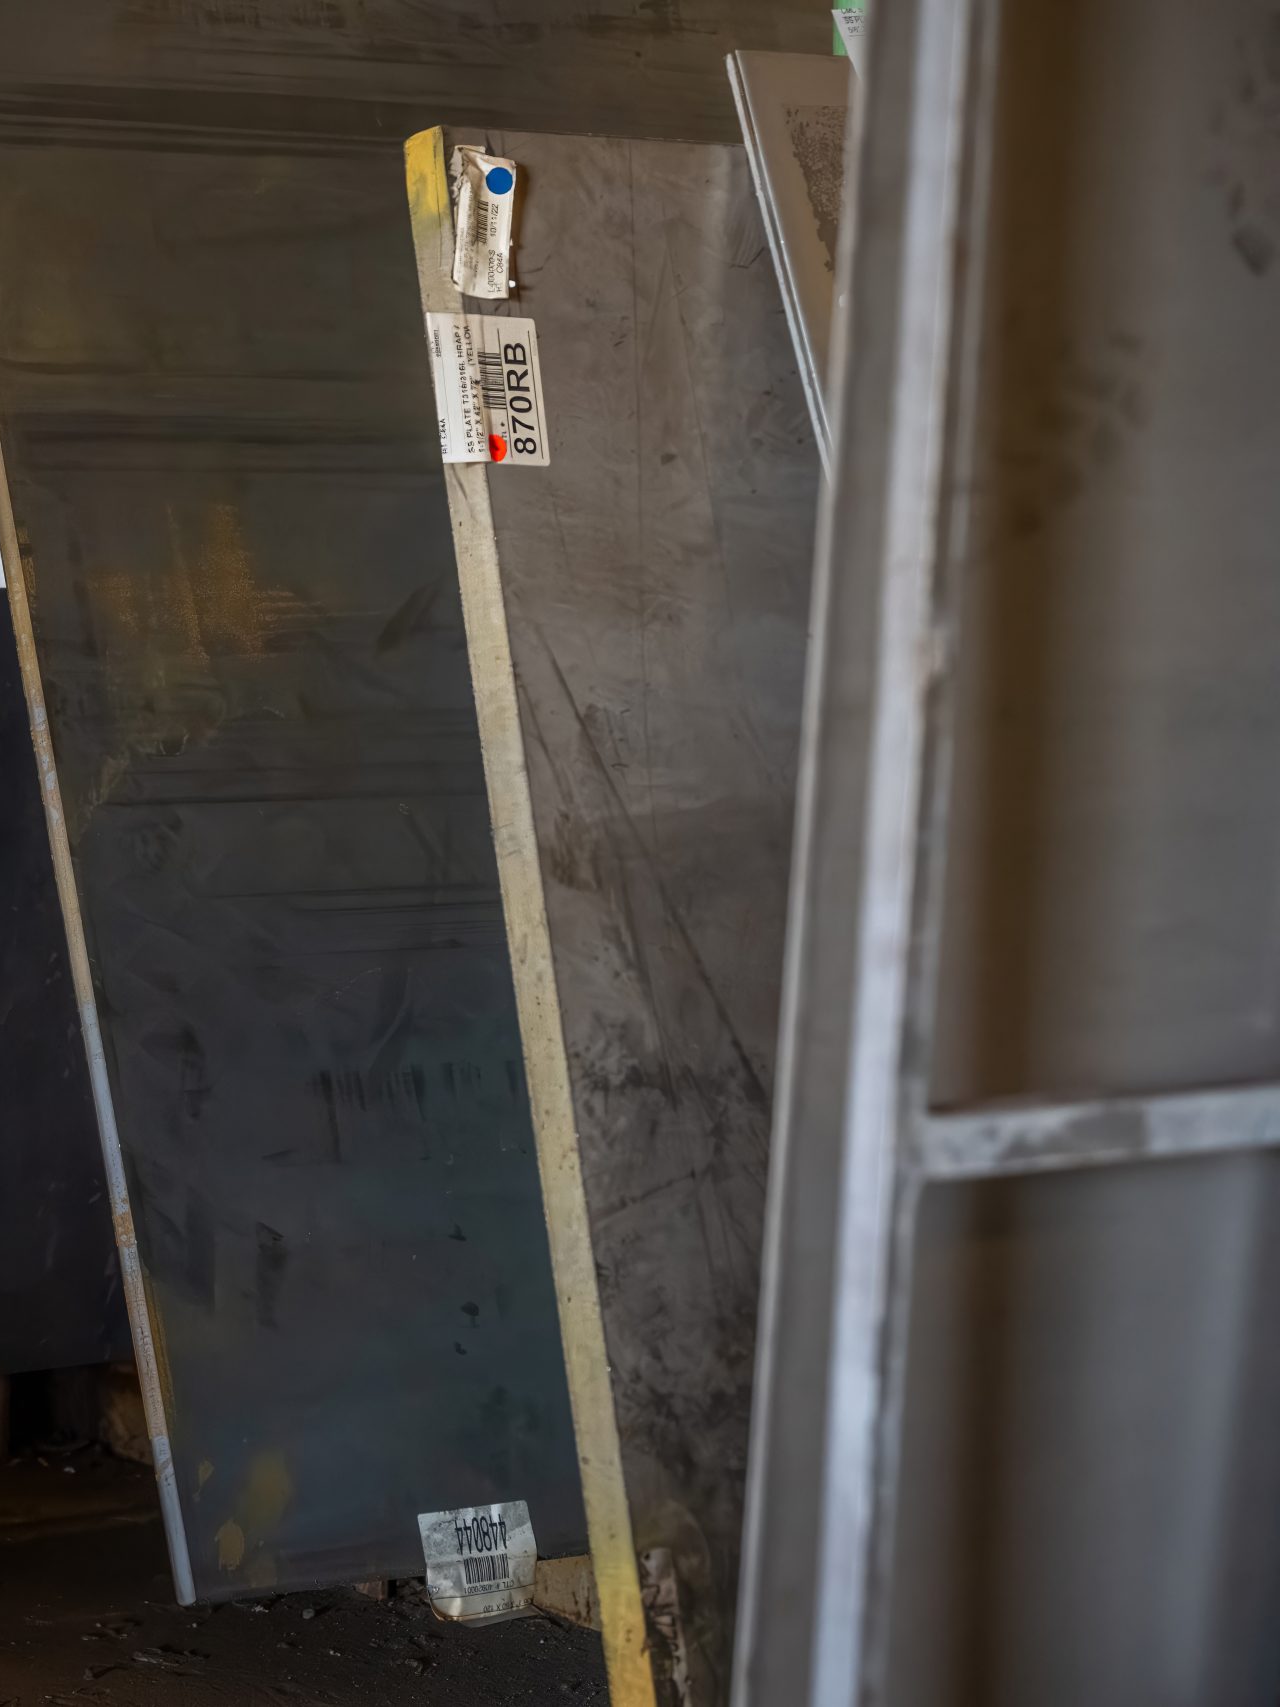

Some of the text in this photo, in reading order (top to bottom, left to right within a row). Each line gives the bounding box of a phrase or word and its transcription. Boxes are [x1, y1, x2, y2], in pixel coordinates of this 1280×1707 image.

[489, 203, 498, 238] 10/11/22
[455, 331, 465, 358] HRAP
[503, 342, 537, 455] 870RB
[463, 408, 473, 438] PLATE
[454, 1513, 508, 1556] 448044
